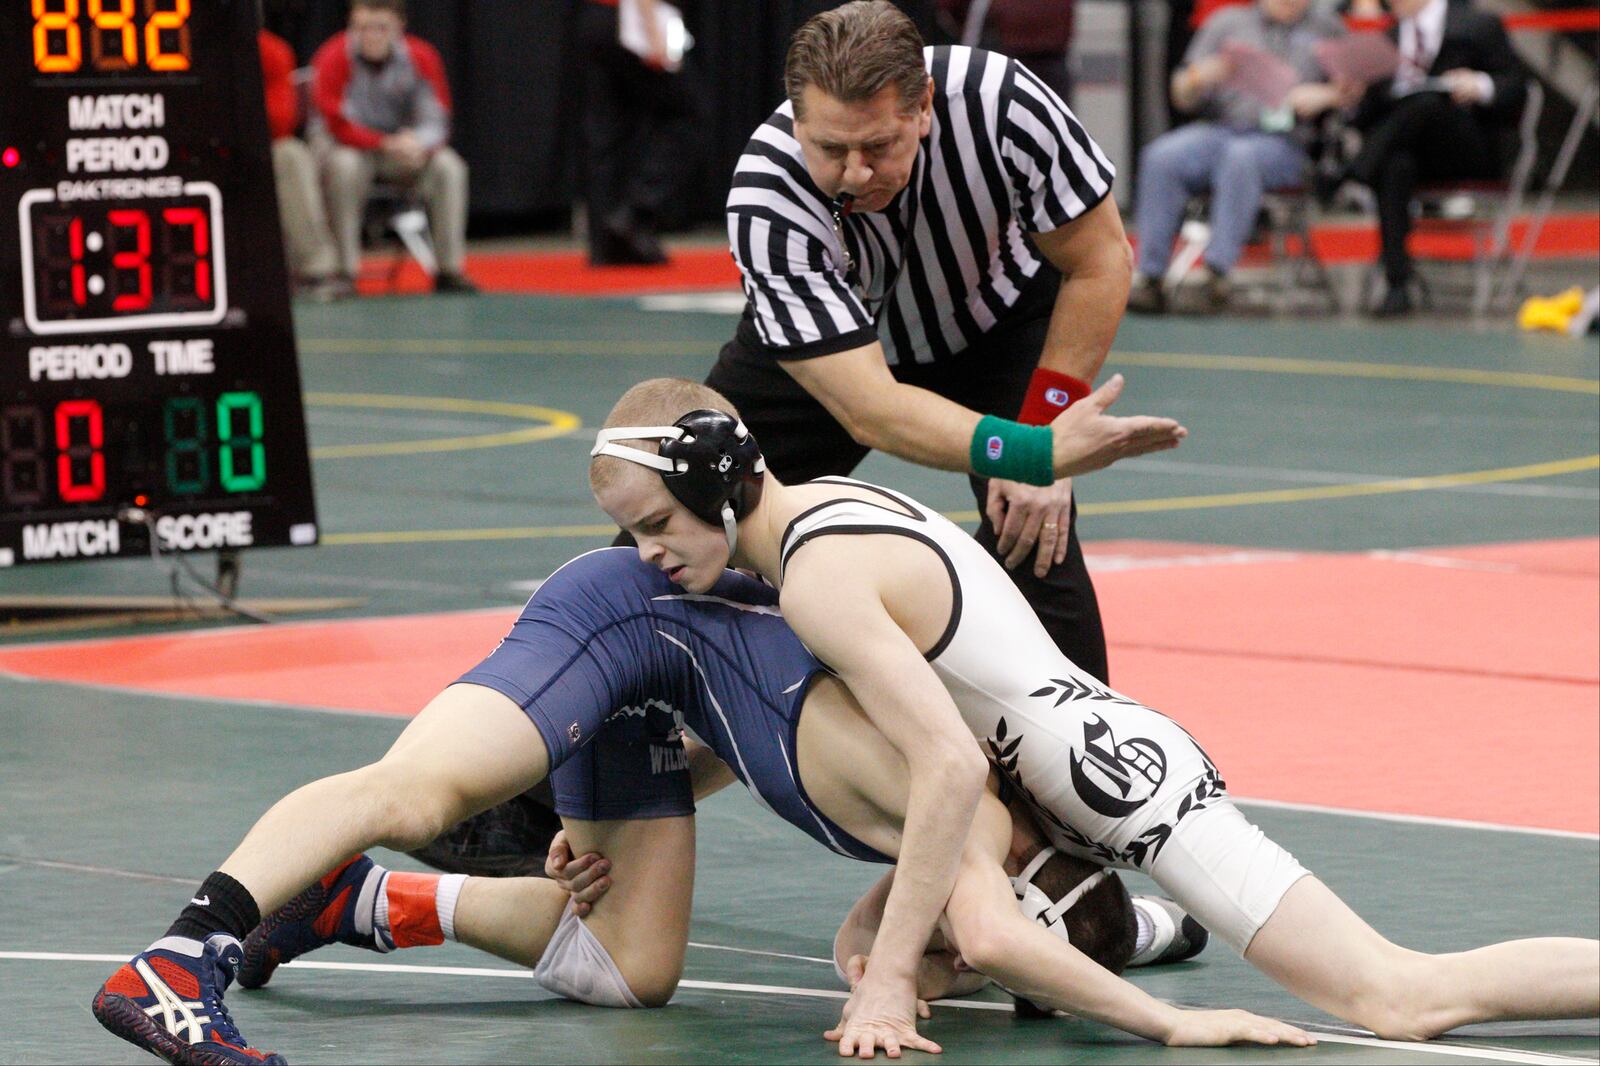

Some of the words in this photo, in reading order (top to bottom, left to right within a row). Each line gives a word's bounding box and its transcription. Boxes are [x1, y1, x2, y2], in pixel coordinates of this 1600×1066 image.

[68, 93, 165, 130] MATCH
[66, 136, 169, 173] PERIOD
[69, 207, 210, 311] 1:37
[28, 343, 132, 382] PERIOD
[148, 339, 215, 375] TIME
[54, 399, 106, 501] 0
[216, 390, 266, 493] 0
[22, 519, 120, 560] MATCH
[156, 511, 253, 549] SCORE
